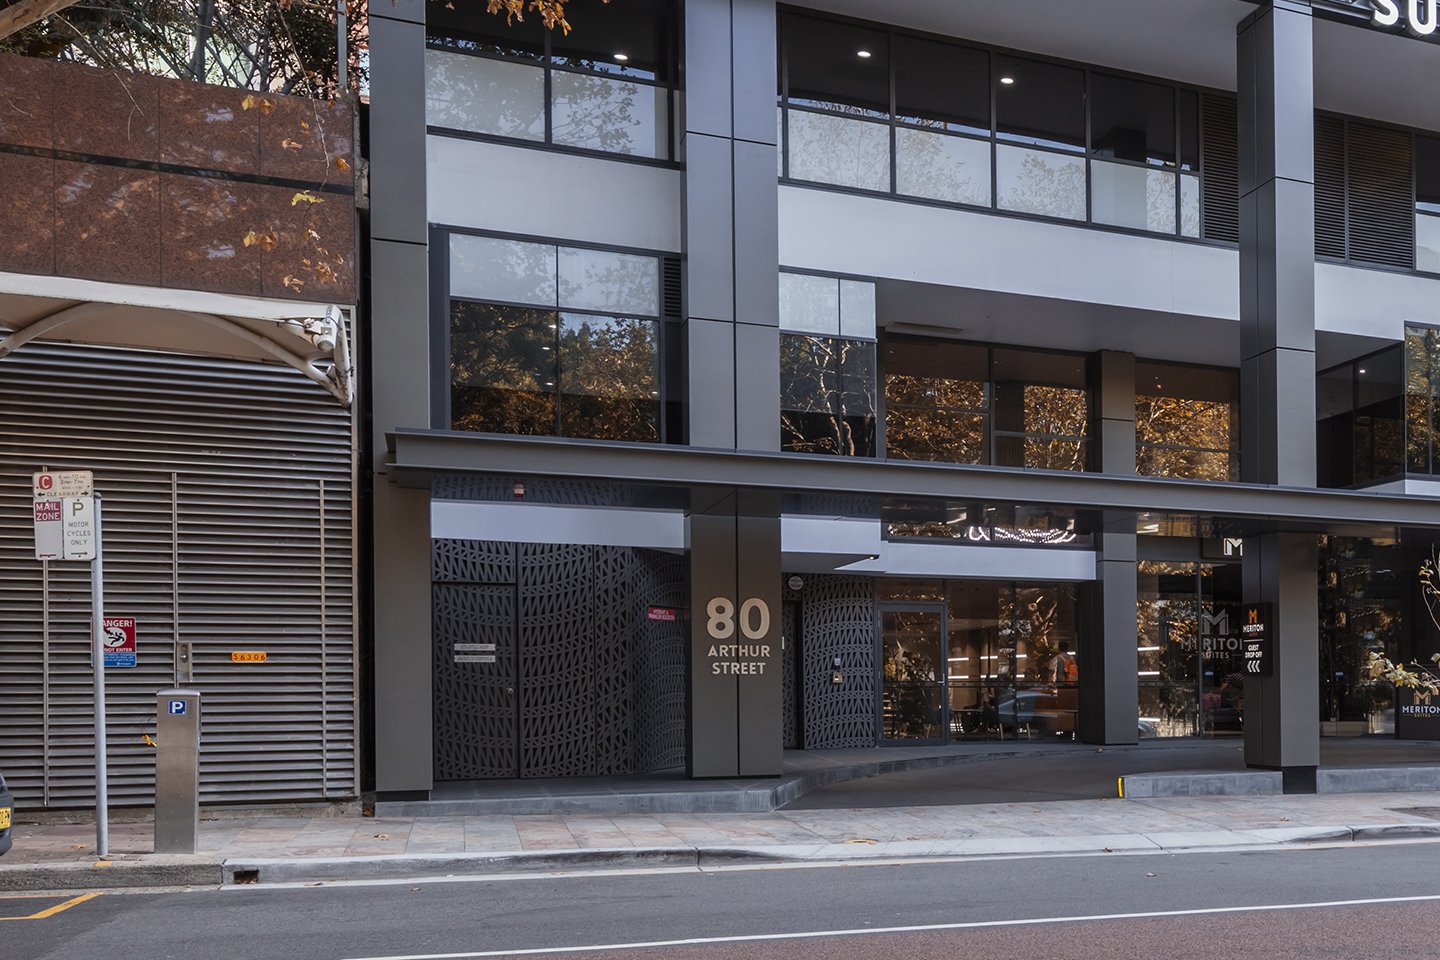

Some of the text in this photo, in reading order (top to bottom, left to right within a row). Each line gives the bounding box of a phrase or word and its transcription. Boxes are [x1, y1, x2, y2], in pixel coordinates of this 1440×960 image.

[36, 502, 60, 511] MAIL
[36, 512, 60, 520] ZONE
[706, 596, 770, 640] 80
[707, 644, 771, 657] ARTHUR
[711, 662, 766, 675] STREET
[171, 701, 184, 714] P
